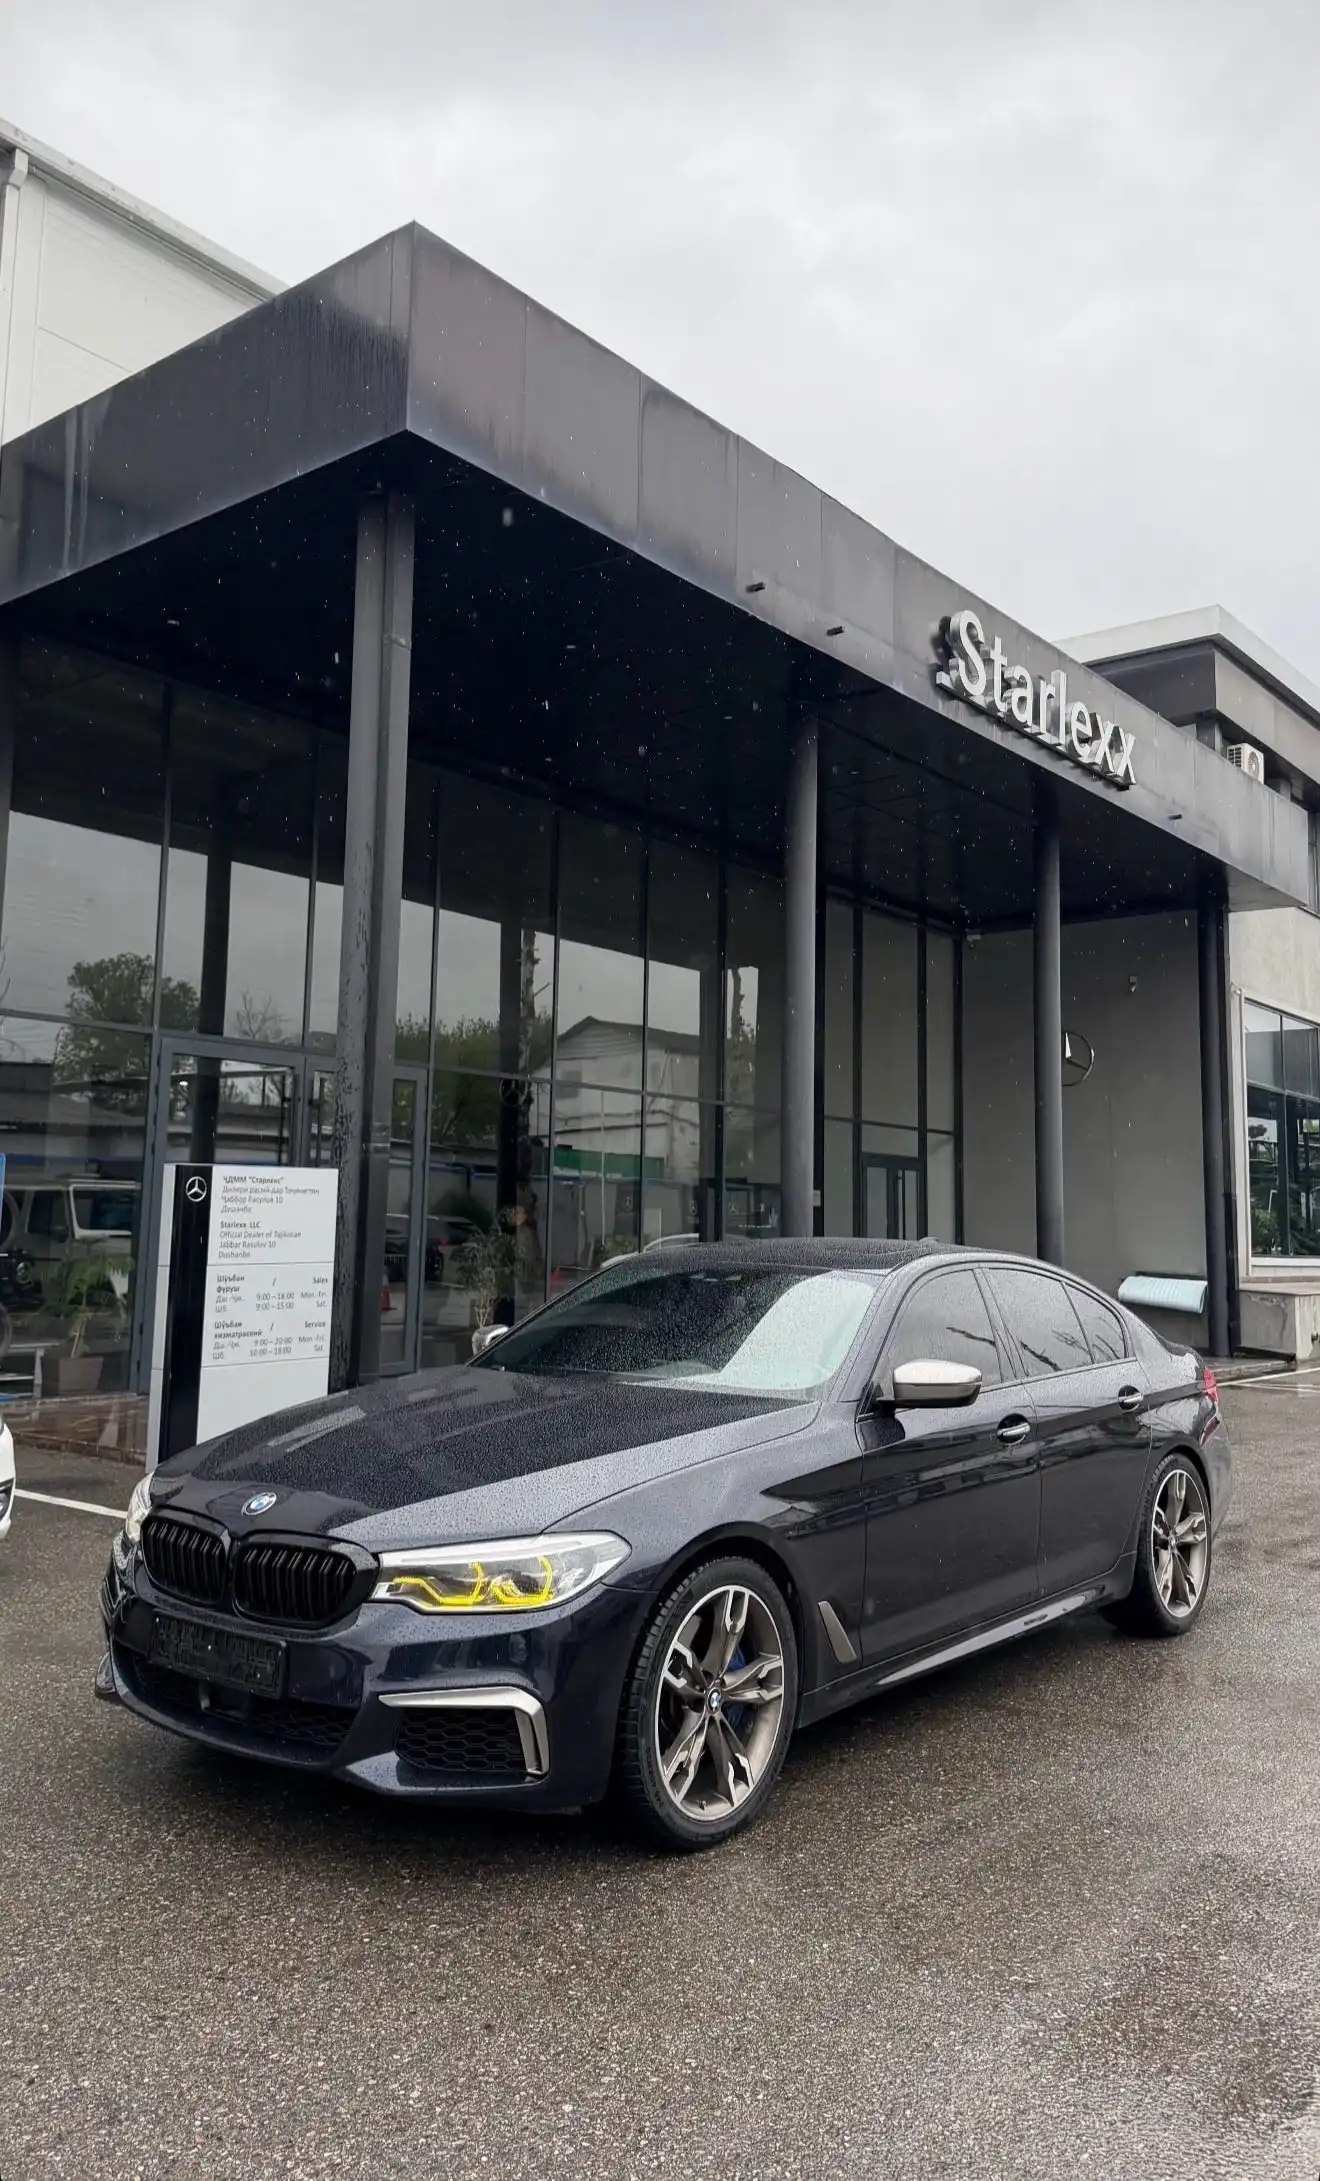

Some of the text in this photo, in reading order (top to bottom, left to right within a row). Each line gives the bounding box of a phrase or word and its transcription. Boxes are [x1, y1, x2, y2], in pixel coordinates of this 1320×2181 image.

[949, 610, 1136, 786] Starlexx
[275, 1196, 284, 1204] 10
[220, 1205, 252, 1214] Душанбе
[220, 1221, 261, 1229] Starlexx LLC
[219, 1231, 242, 1239] Official
[243, 1231, 264, 1239] Dealer
[219, 1241, 241, 1249] Jabbar
[242, 1241, 266, 1249] Rasulov
[218, 1251, 250, 1259] Dushanbe
[313, 1276, 328, 1284] Sales
